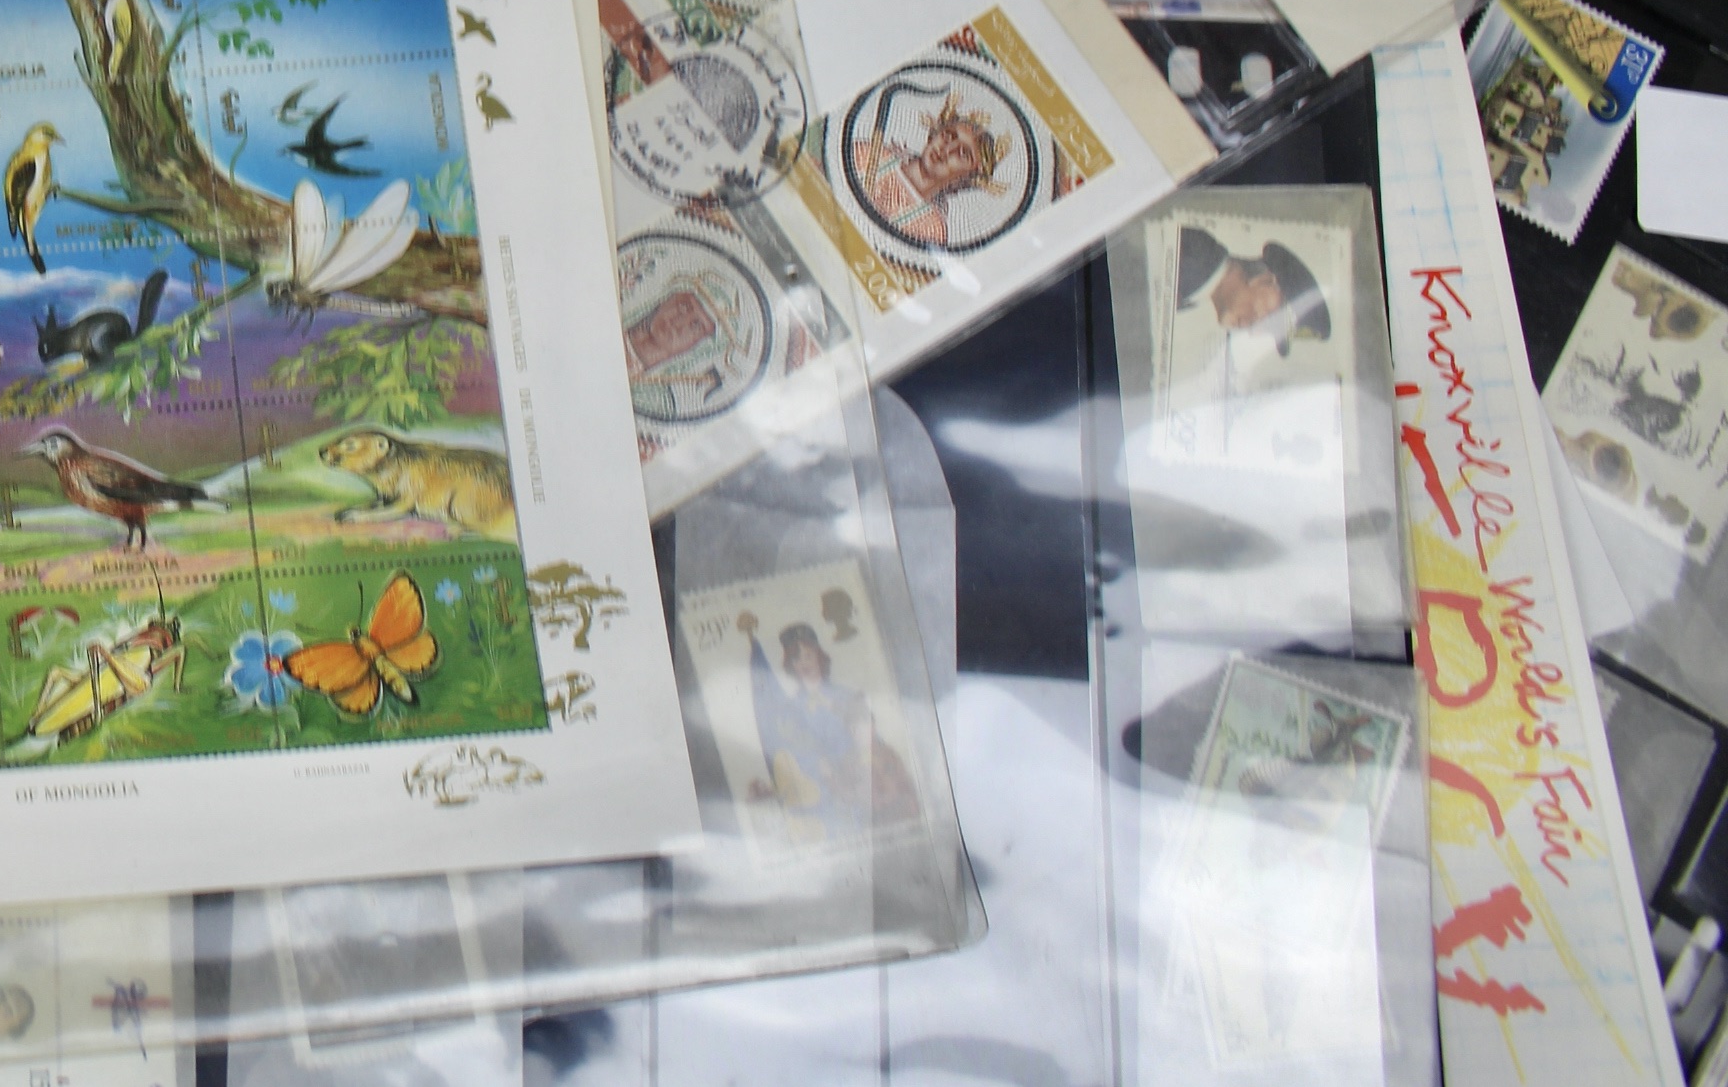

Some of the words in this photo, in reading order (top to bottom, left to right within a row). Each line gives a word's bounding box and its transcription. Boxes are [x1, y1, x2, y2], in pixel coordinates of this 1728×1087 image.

[1410, 267, 1515, 575] Knoxville
[1513, 765, 1593, 889] Fair
[14, 786, 40, 805] OF
[43, 778, 141, 802] MONGOLIA
